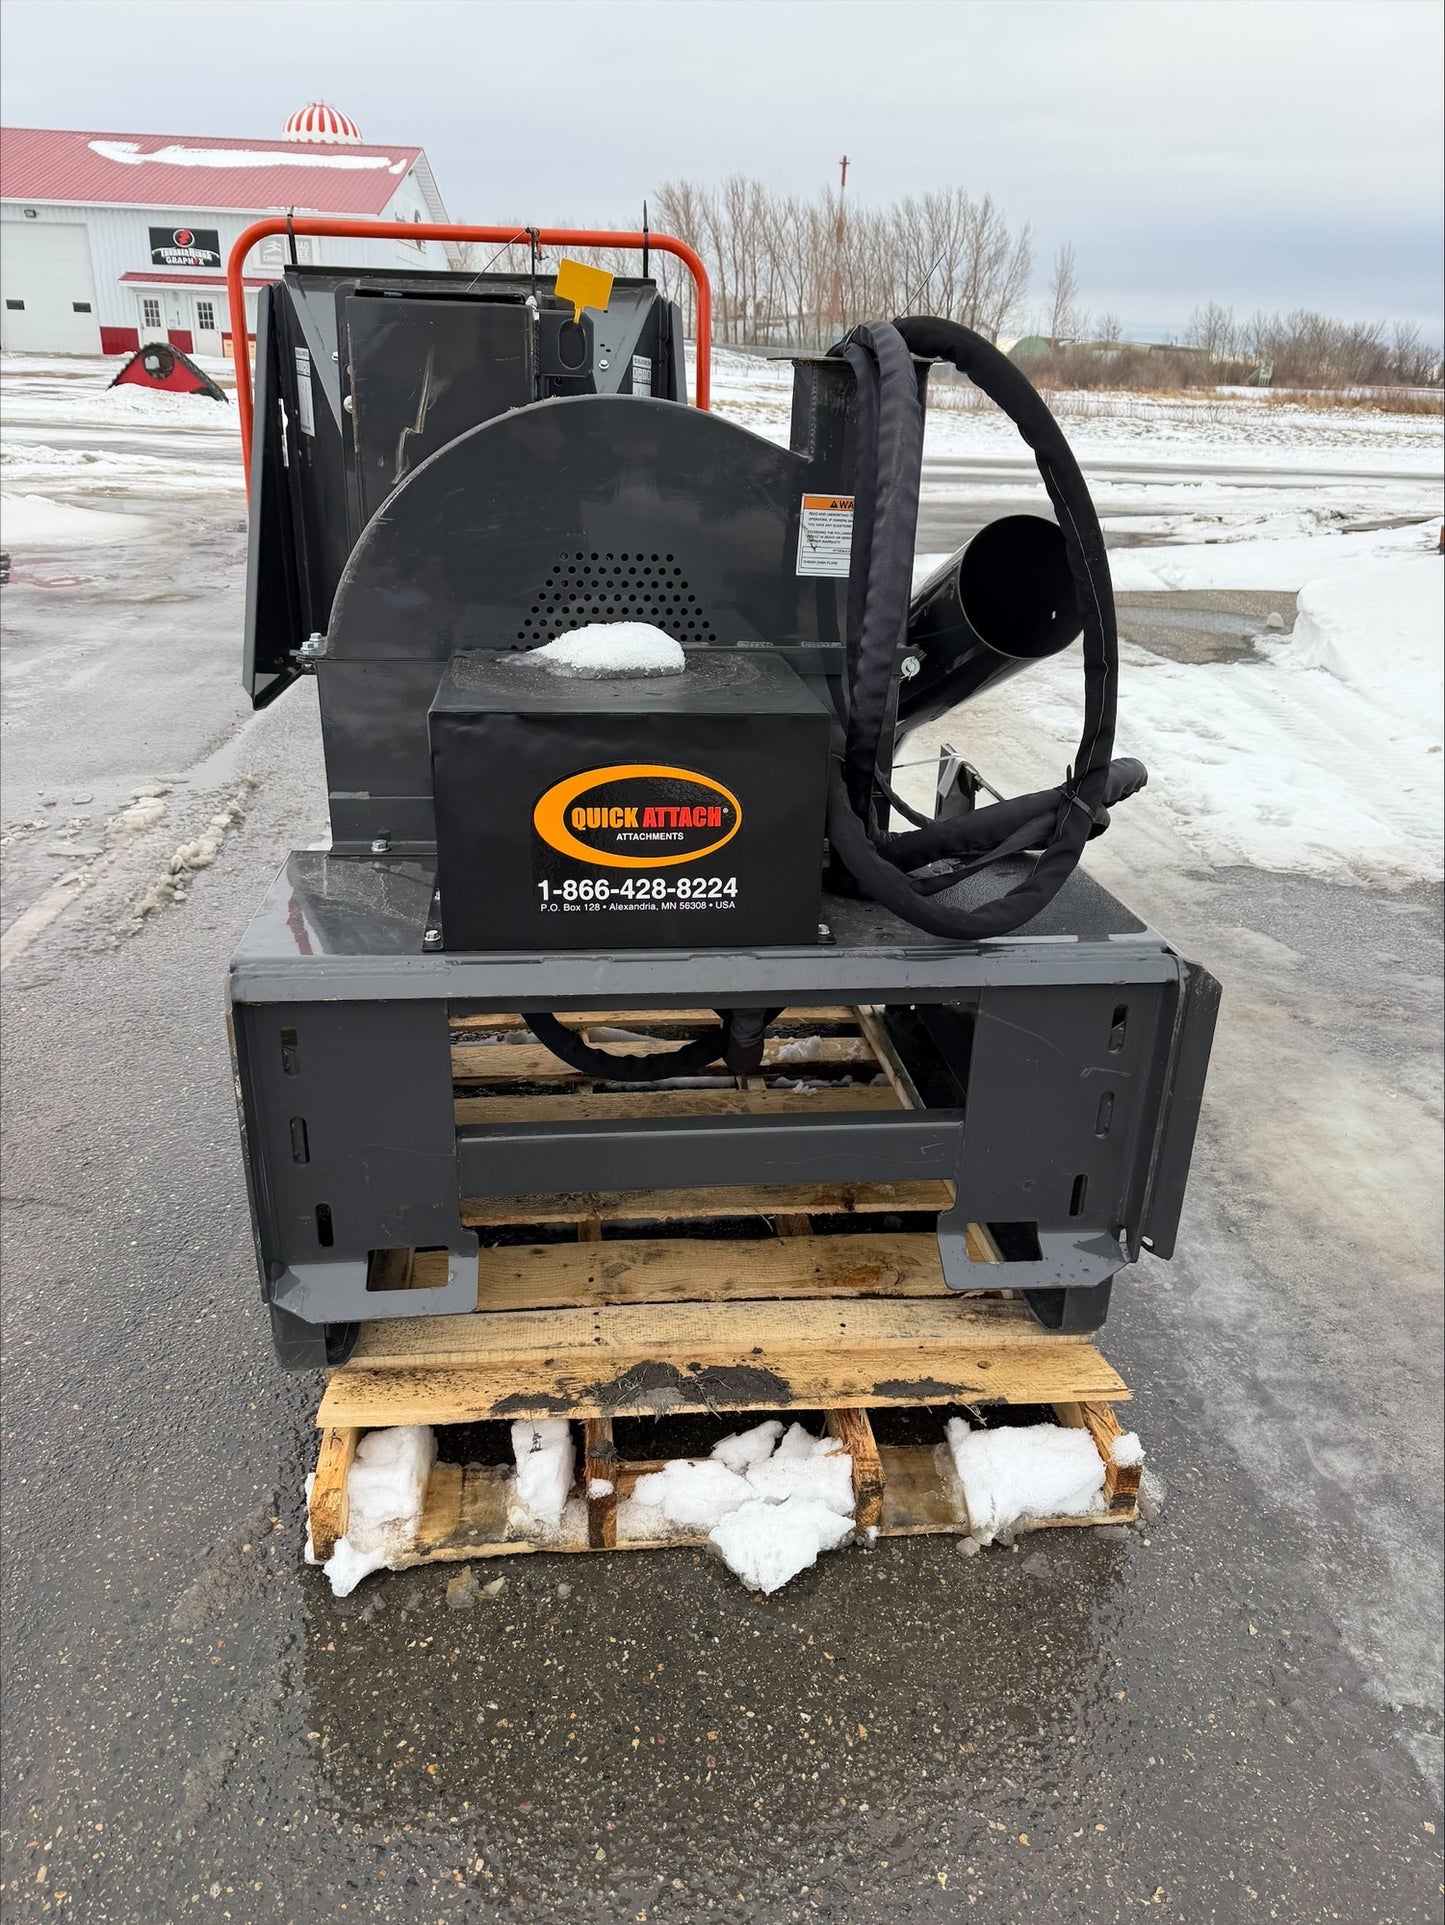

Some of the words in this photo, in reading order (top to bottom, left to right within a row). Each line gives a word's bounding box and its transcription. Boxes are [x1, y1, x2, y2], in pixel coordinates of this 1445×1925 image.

[839, 500, 854, 509] WA
[571, 806, 639, 830] QUICK
[642, 806, 721, 828] ATTACH
[616, 832, 684, 841] ATTACHMENTS
[537, 877, 738, 901] 1-866-428-8224
[540, 903, 561, 912] P.O.
[563, 903, 581, 912] Box
[584, 903, 601, 911] 128
[609, 902, 659, 911] Alexandria,
[661, 901, 677, 910] MN
[679, 901, 707, 910] 56308
[715, 900, 736, 909] USA
